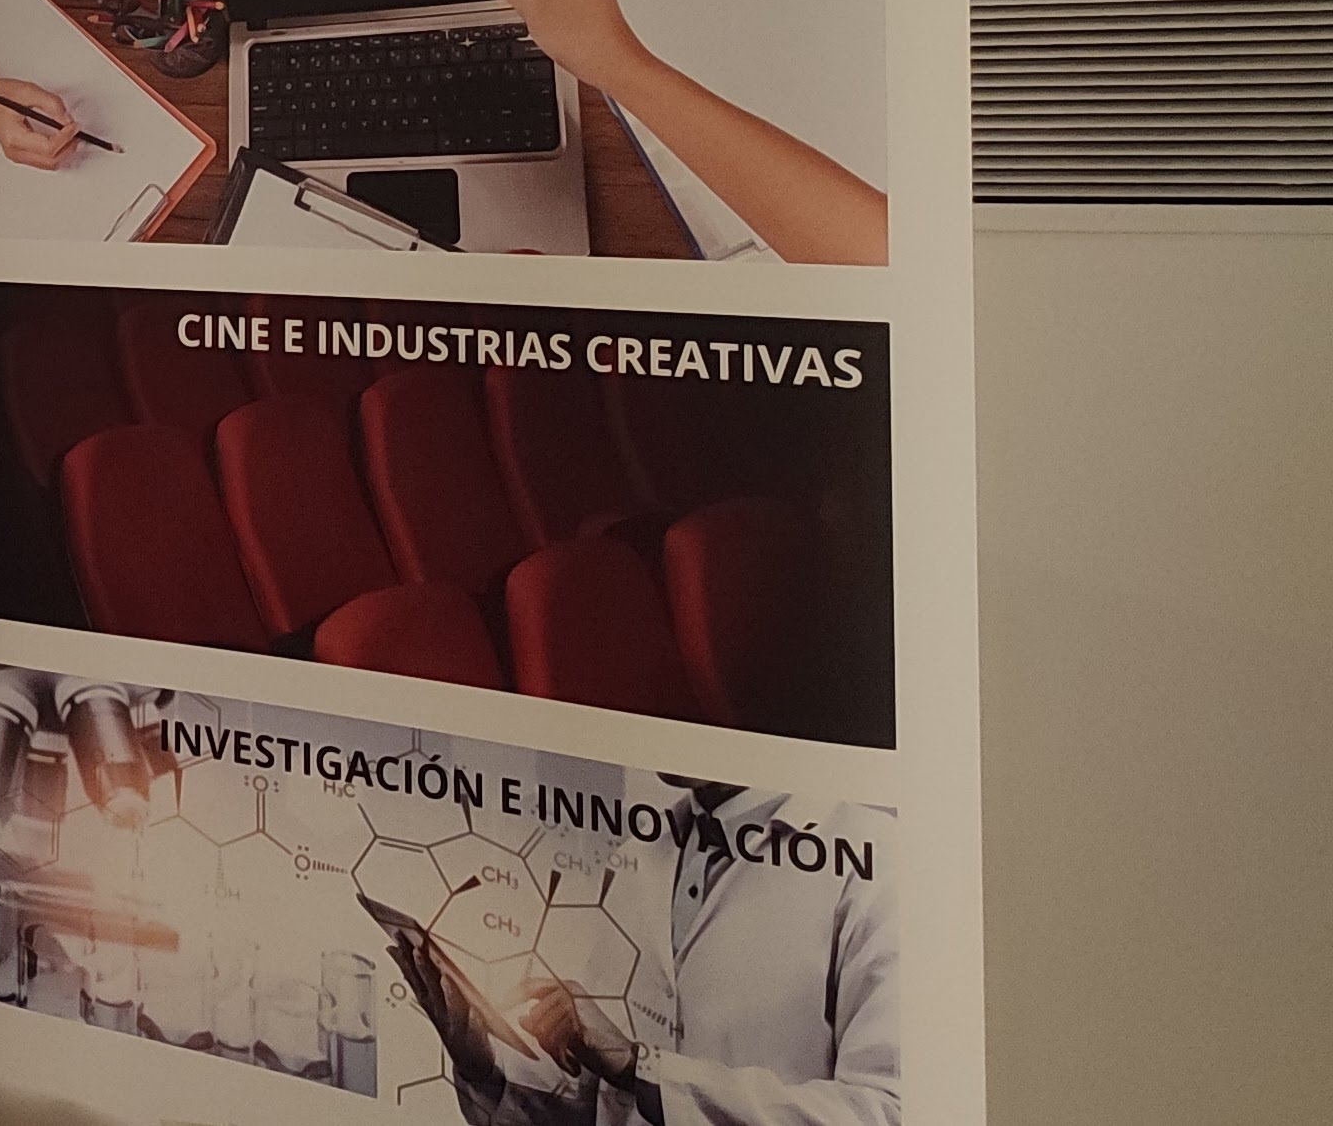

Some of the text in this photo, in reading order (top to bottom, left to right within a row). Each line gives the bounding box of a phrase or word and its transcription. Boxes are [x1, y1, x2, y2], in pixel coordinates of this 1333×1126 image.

[176, 311, 864, 390] CINE E INDUSTRIAS CREATIVAS
[157, 718, 874, 882] INVESTIGACIÓN E INNOVACIÓN
